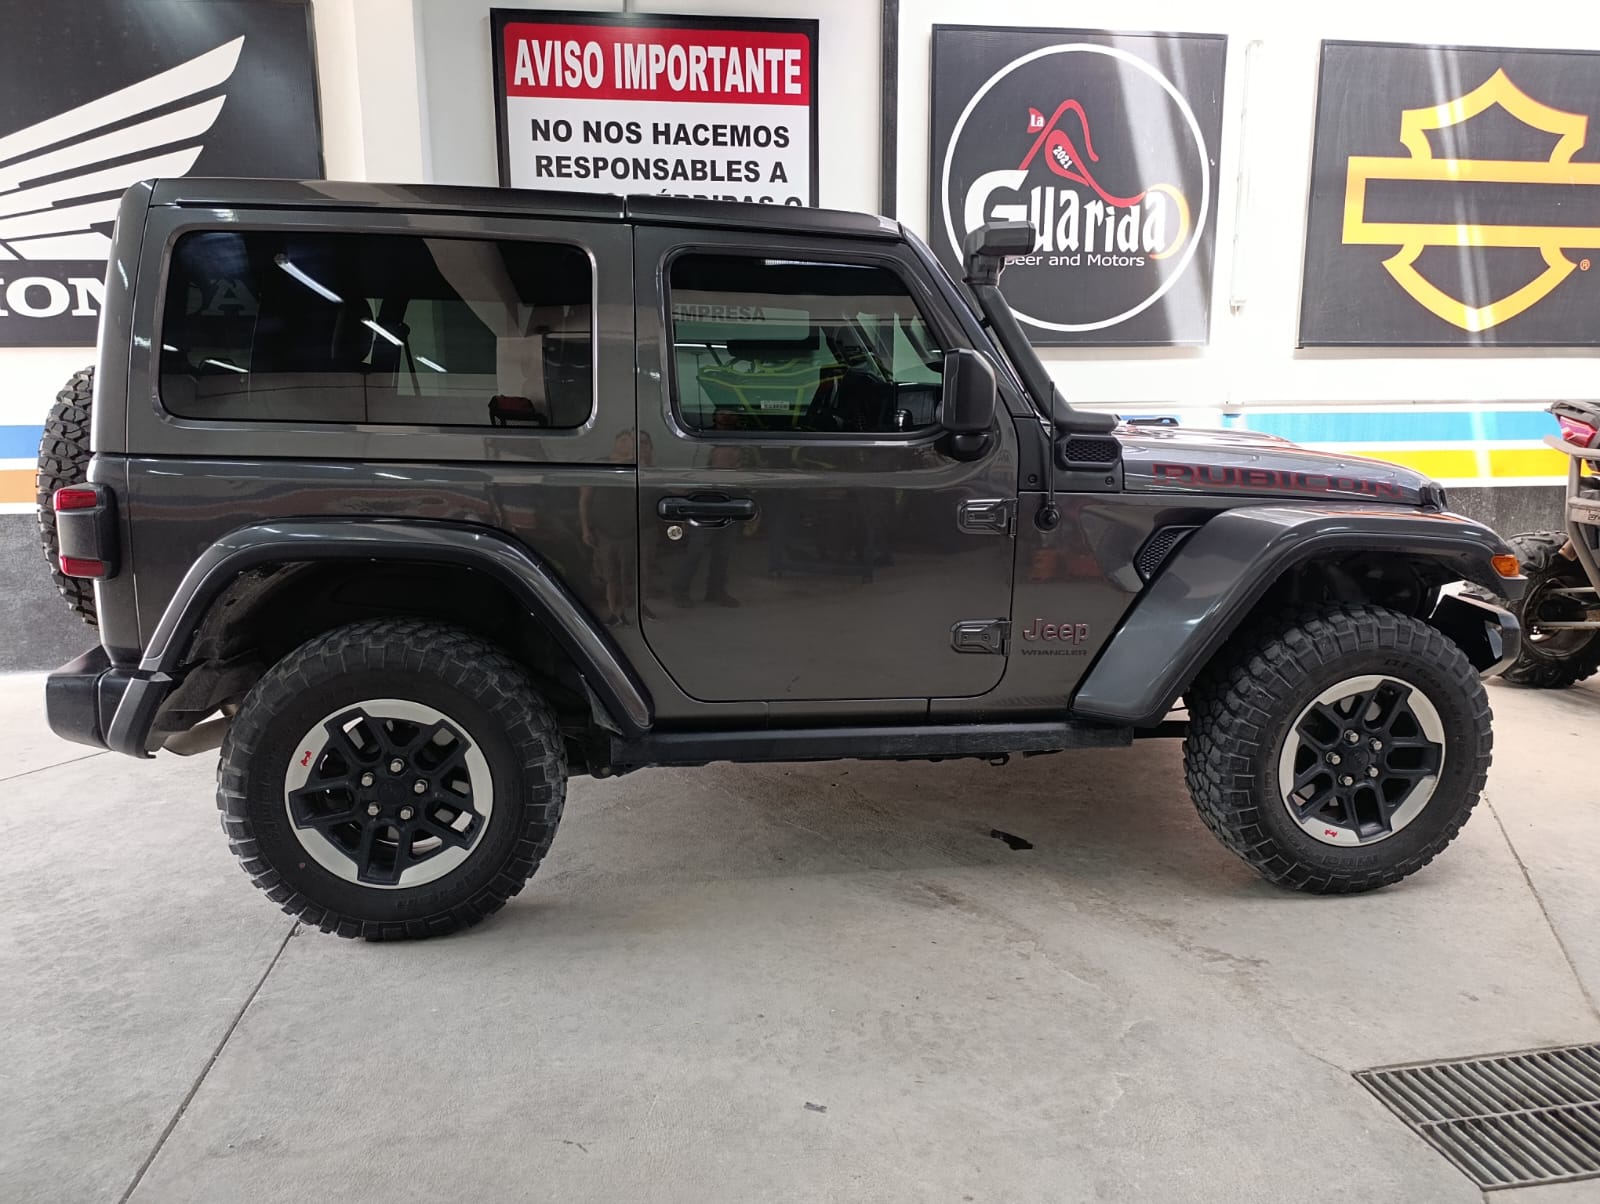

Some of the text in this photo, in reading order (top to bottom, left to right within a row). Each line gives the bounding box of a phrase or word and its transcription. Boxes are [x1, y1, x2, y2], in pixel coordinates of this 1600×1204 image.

[513, 39, 802, 94] AVISO IMPORTANTE
[531, 118, 790, 148] NO NOS HACEMOS
[1029, 113, 1045, 127] La
[535, 155, 789, 183] RESPONSABLES A
[1052, 145, 1073, 170] 2021
[1048, 253, 1081, 267] and
[1087, 254, 1146, 267] Motors
[1152, 463, 1402, 498] RUBICON
[1023, 618, 1089, 645] Jeep
